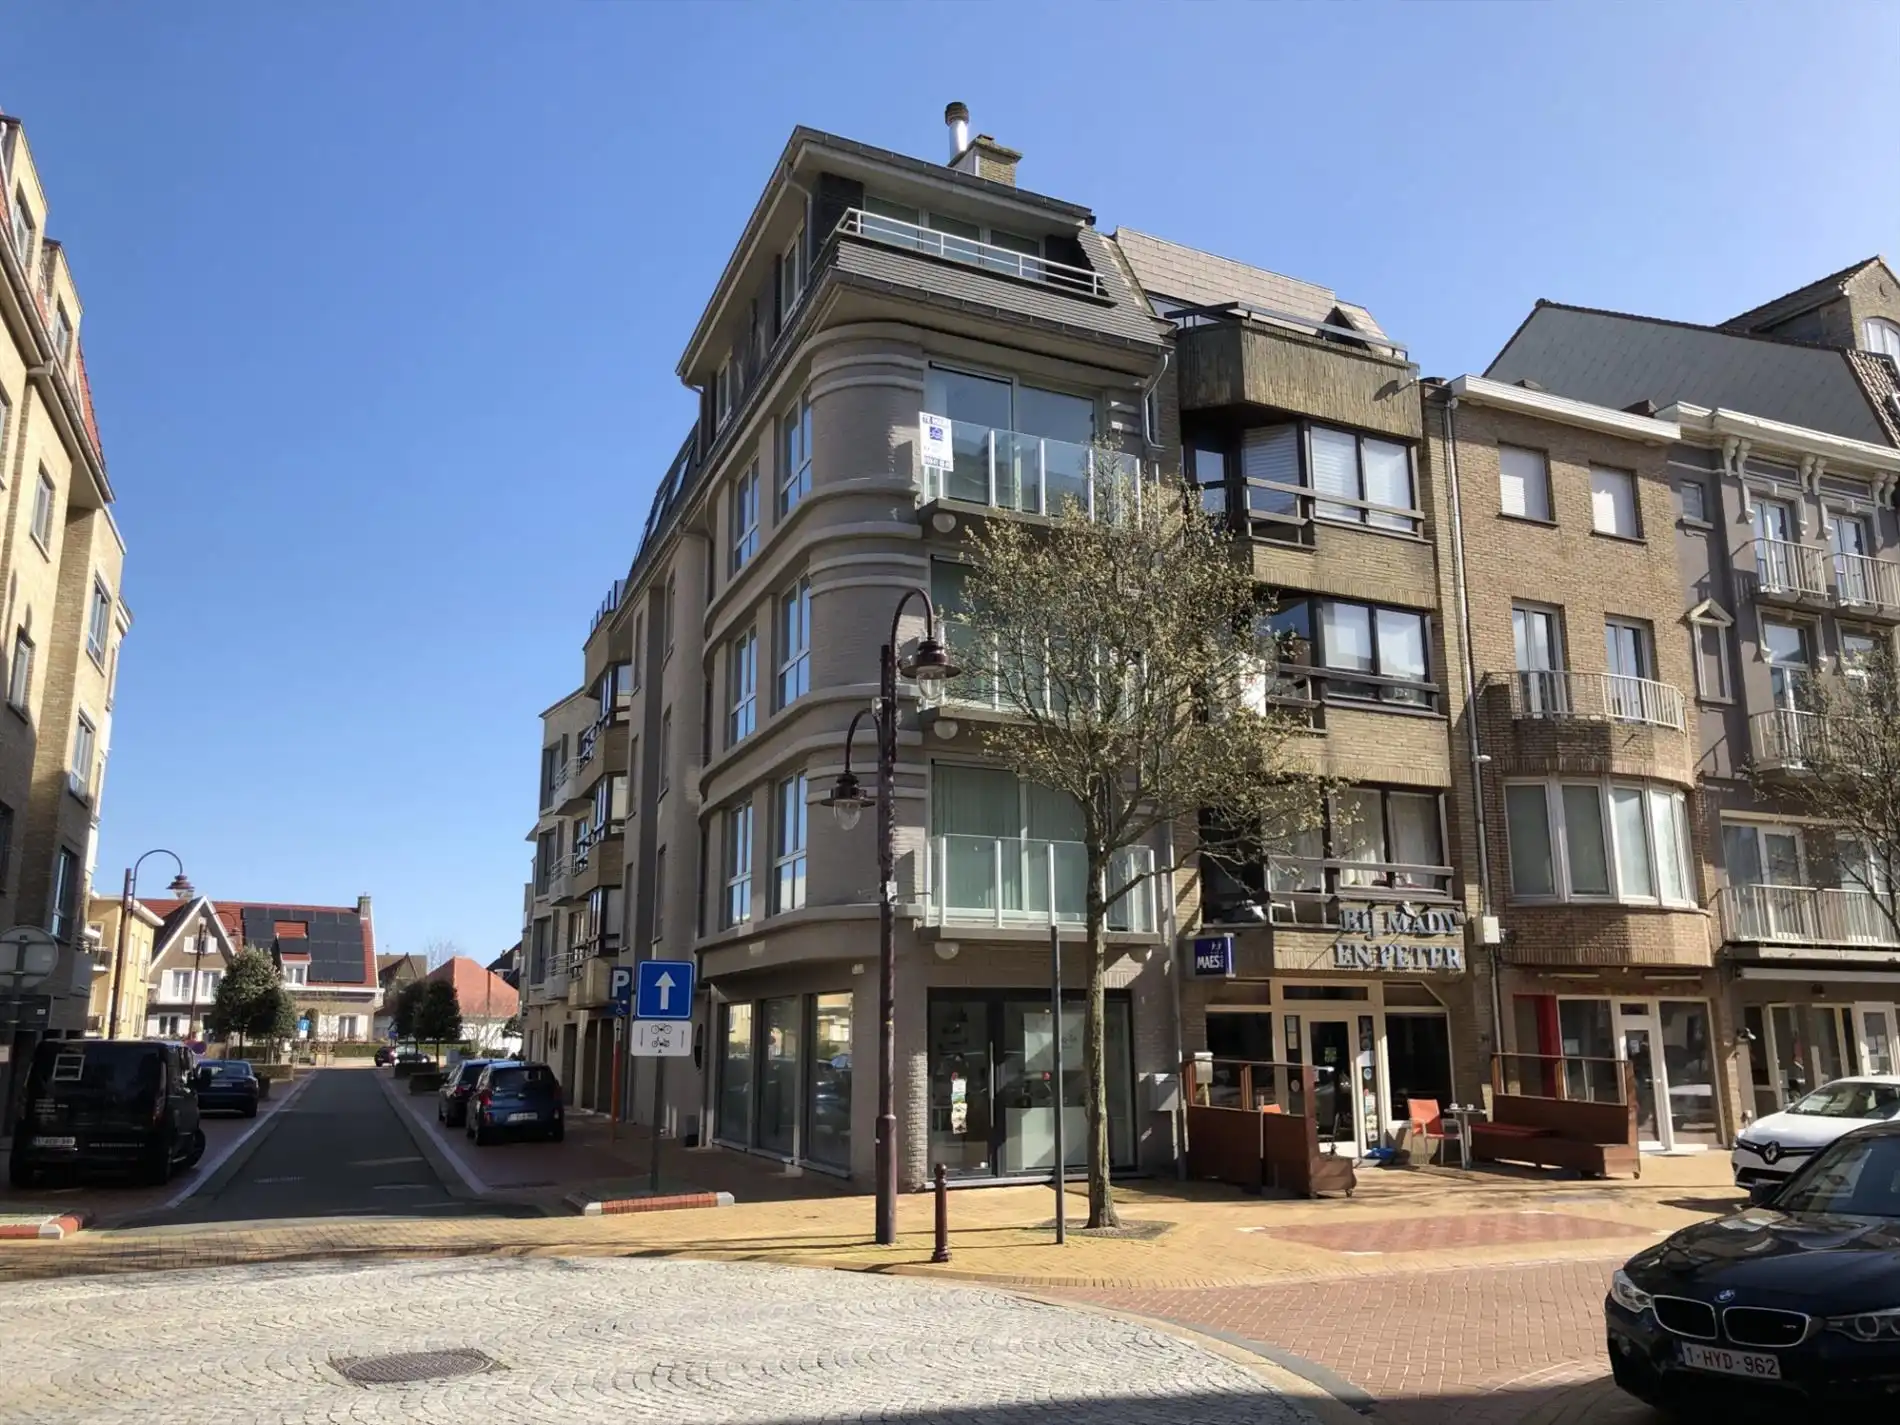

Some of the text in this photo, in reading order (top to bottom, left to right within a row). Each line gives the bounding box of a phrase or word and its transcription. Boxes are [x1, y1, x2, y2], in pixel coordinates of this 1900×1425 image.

[1382, 911, 1458, 935] MADY
[1197, 955, 1220, 968] MAES
[1334, 943, 1460, 970] EN PETER
[612, 970, 630, 997] P
